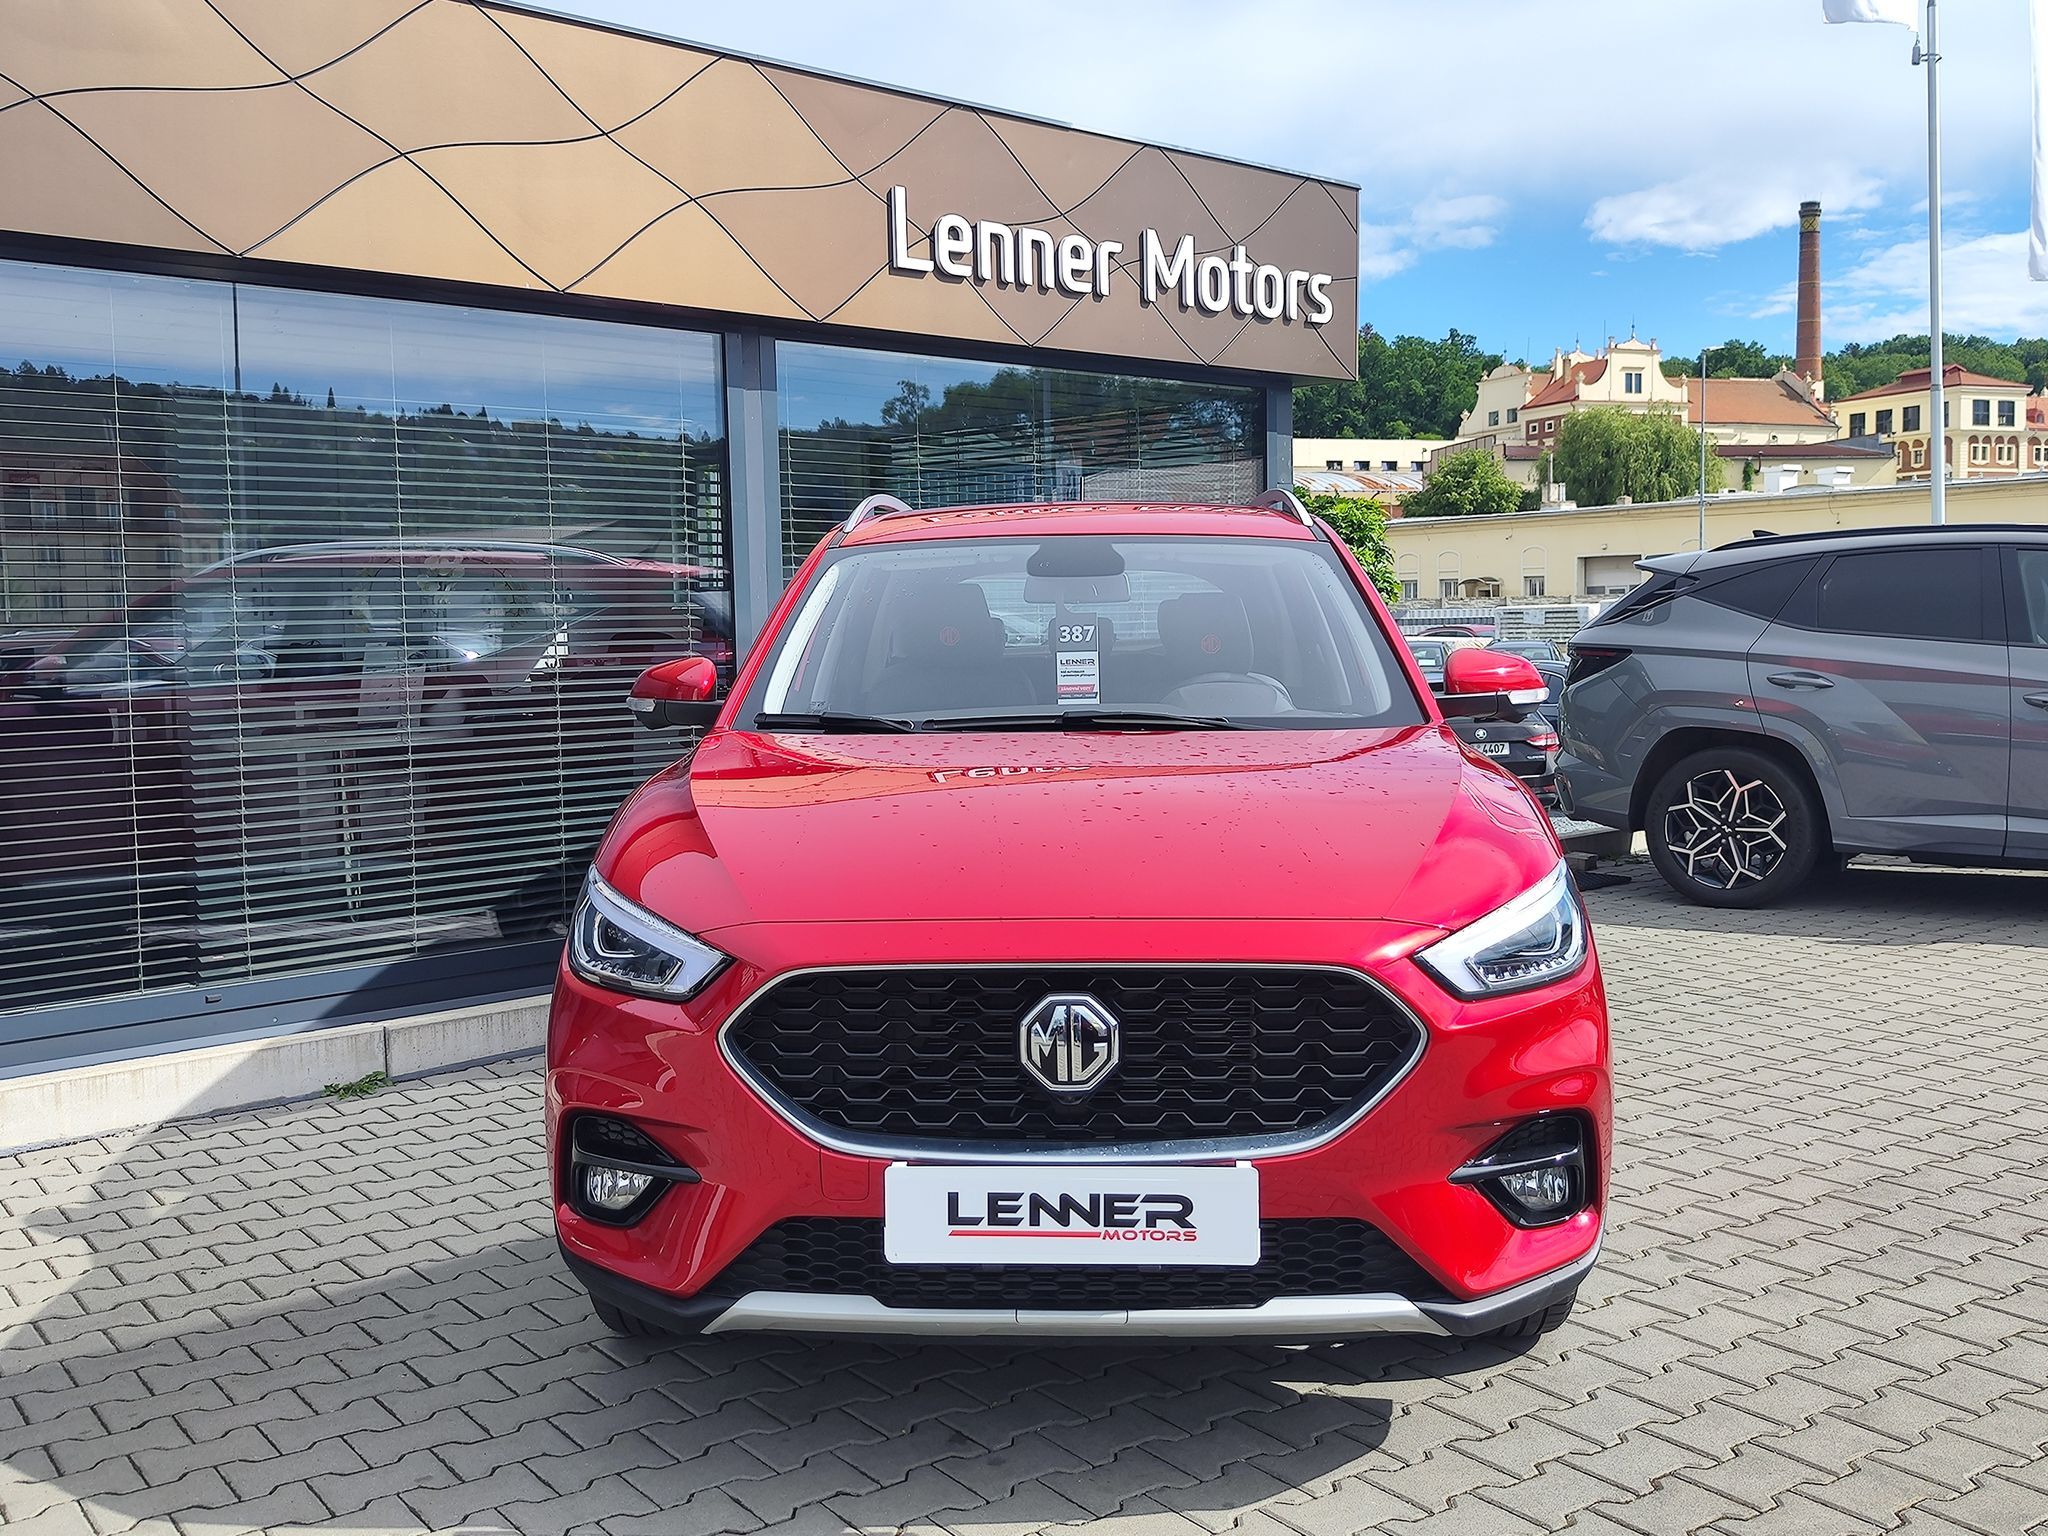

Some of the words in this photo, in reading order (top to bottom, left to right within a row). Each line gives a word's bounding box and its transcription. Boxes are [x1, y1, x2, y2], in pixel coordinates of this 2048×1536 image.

[888, 184, 1124, 300] Lenner
[1141, 227, 1334, 325] Motors
[1059, 625, 1095, 642] 387
[1060, 658, 1095, 666] LENNER
[1482, 743, 1505, 754] 4407
[1031, 1005, 1107, 1081] MG
[948, 1191, 1197, 1229] LENNER
[1101, 1229, 1198, 1242] MOTORS
